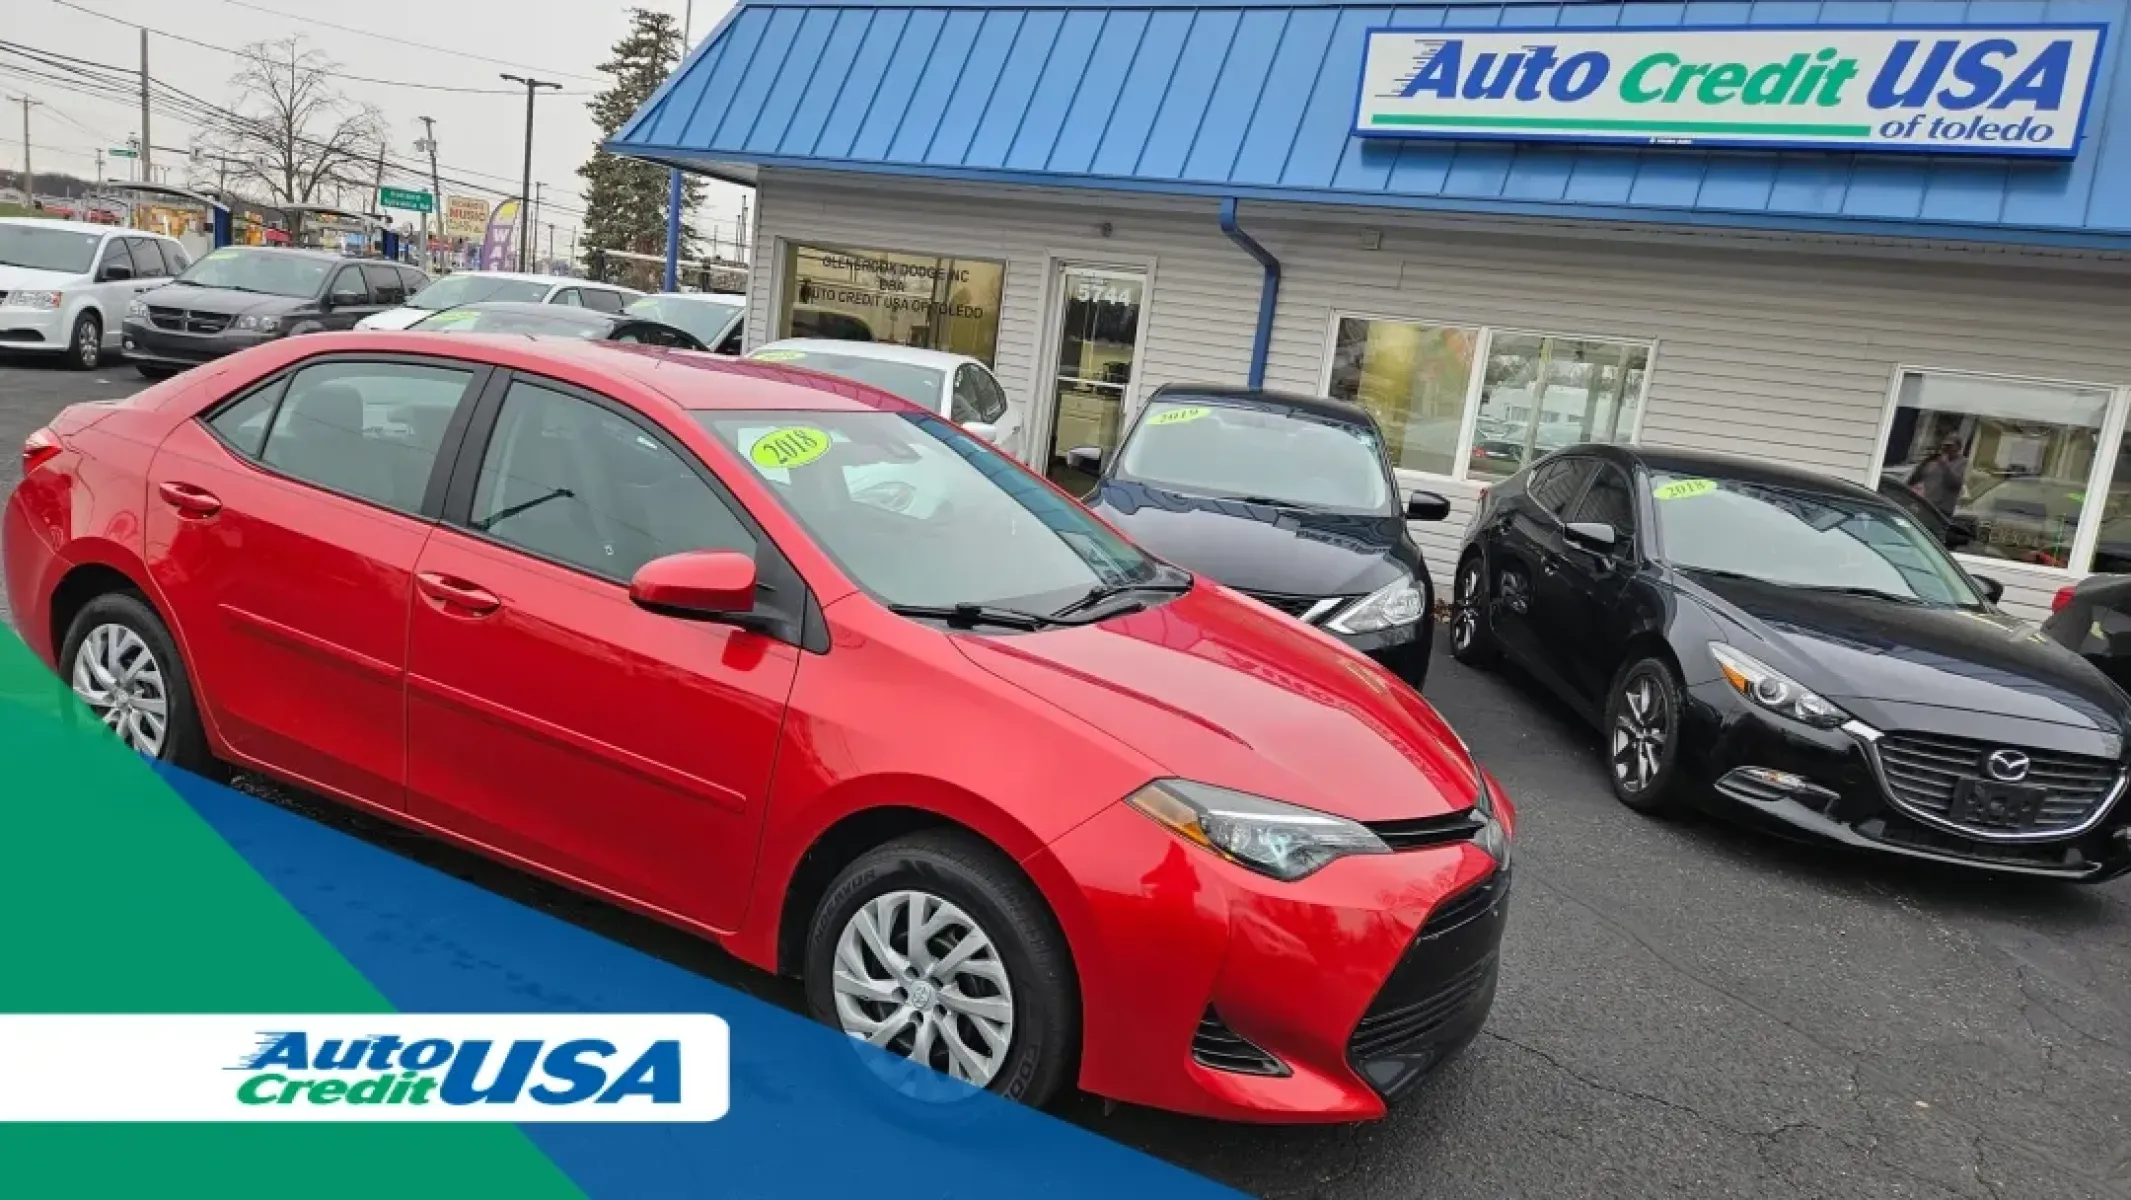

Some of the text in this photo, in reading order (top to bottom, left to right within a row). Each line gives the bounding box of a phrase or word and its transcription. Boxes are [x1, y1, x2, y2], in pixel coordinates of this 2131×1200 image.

[1392, 38, 2073, 111] Auto Credit USA
[1879, 114, 2054, 143] of toledo
[900, 264, 946, 280] DODGE
[948, 268, 970, 283] INC
[838, 291, 881, 307] CREDIT
[883, 295, 909, 311] USA
[911, 298, 929, 312] OF
[932, 301, 984, 319] TOLEDO
[1079, 284, 1132, 306] 5744
[762, 430, 818, 465] 2018
